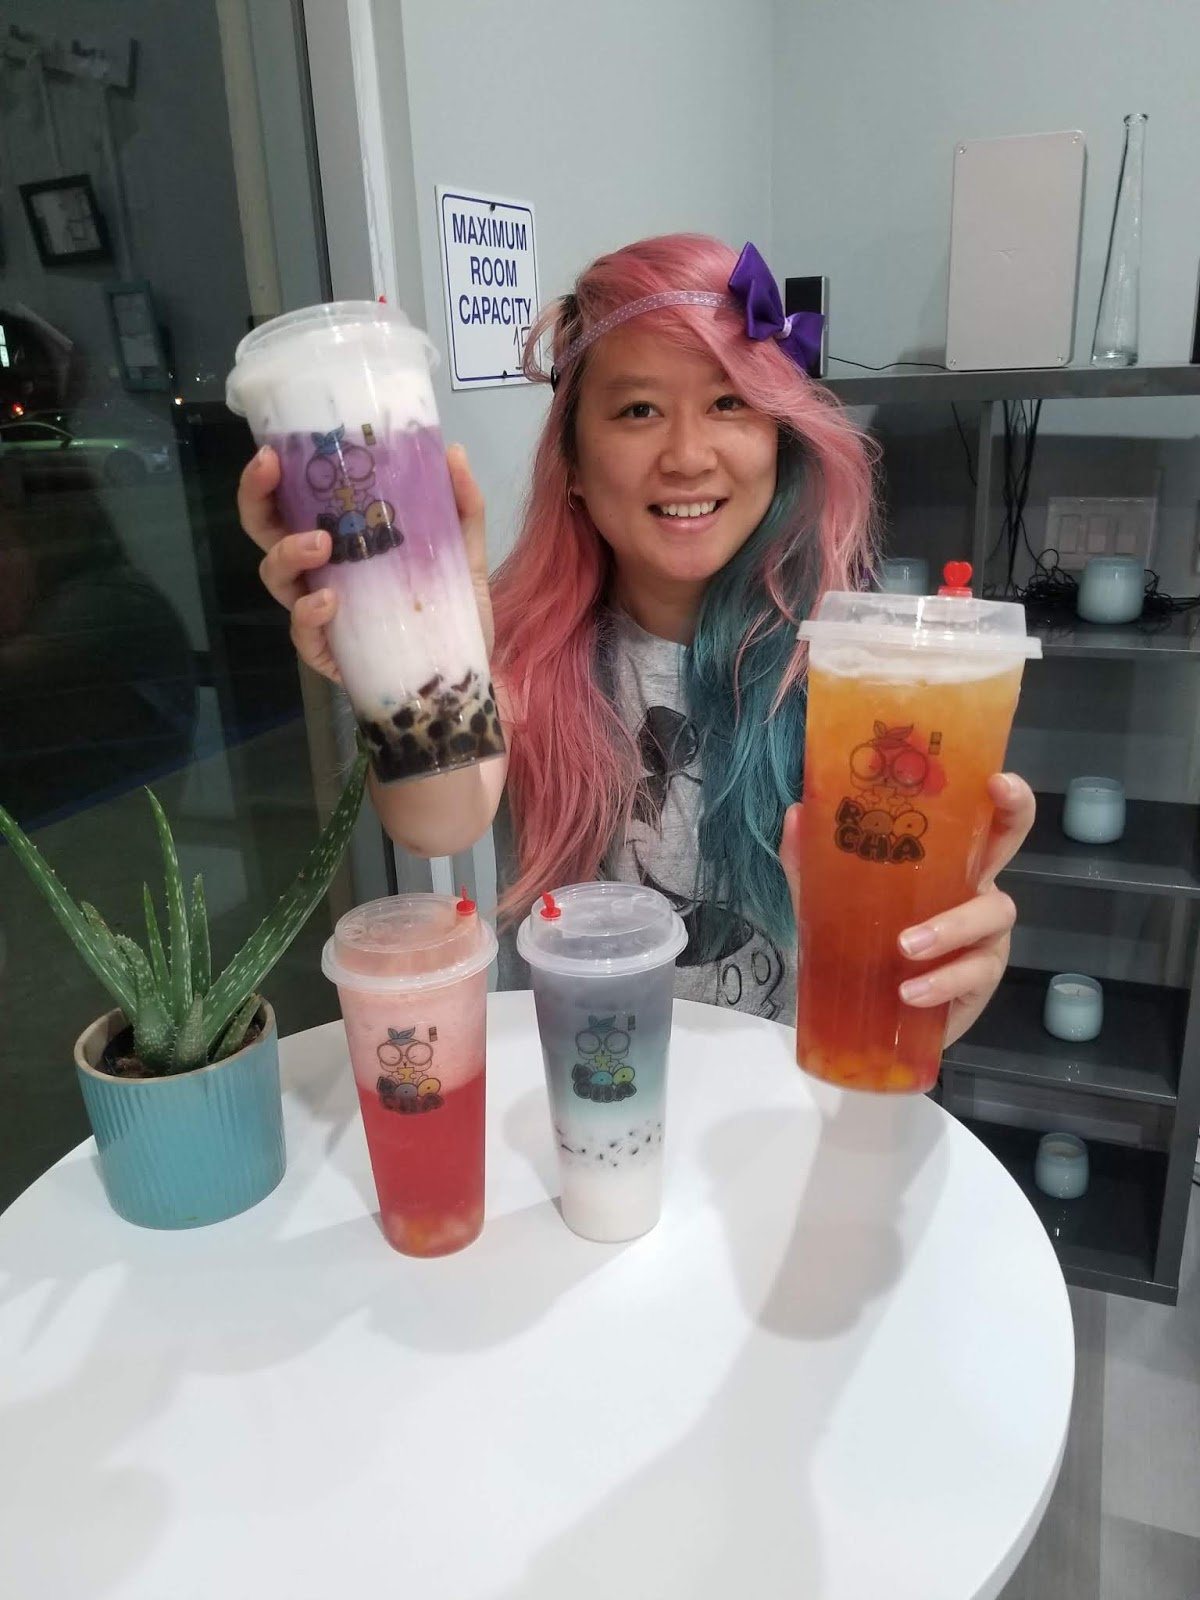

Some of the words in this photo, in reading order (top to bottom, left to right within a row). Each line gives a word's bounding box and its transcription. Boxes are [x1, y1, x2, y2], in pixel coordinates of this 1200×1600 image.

[452, 212, 528, 251] MAXIMUM
[470, 256, 518, 287] ROOM
[458, 294, 532, 325] CAPACITY
[834, 823, 925, 865] CHA
